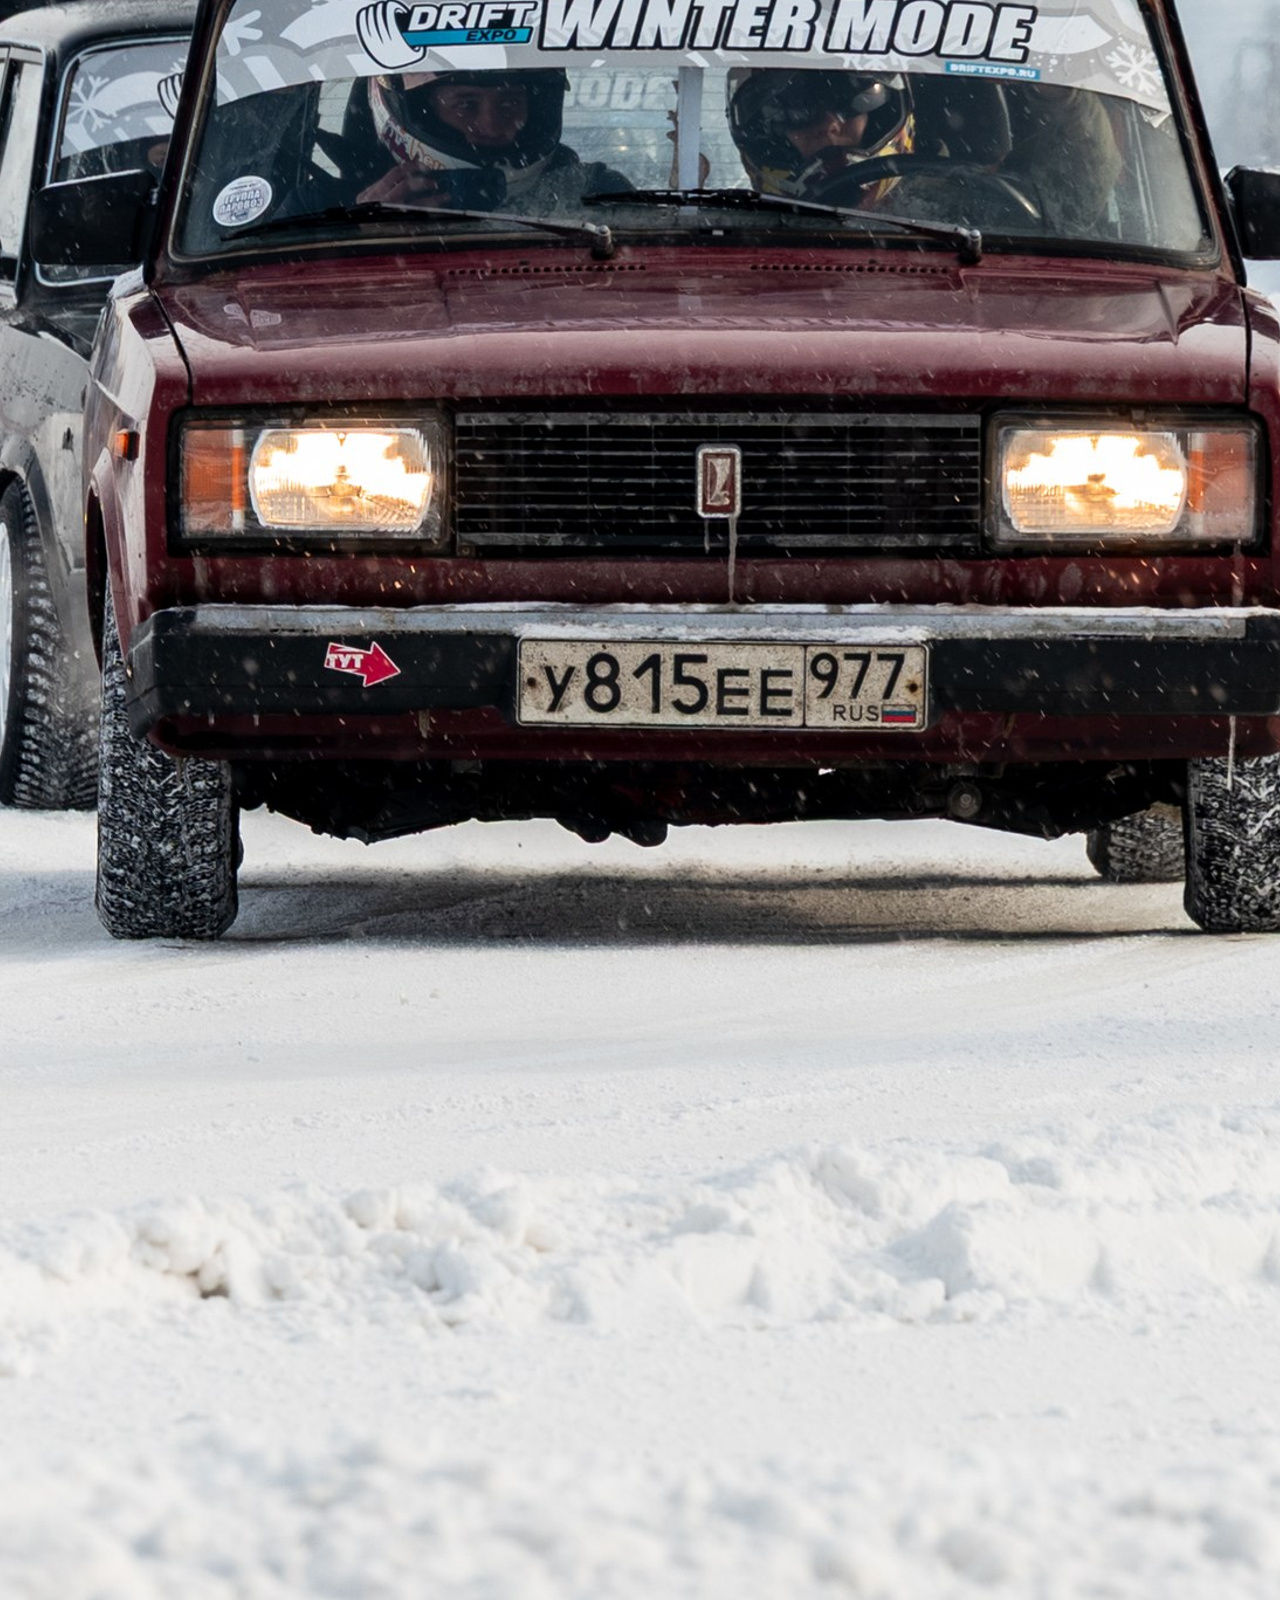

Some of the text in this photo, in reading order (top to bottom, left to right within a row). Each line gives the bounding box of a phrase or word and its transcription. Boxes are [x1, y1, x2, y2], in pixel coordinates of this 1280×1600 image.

[408, 2, 537, 31] DRIFT
[466, 29, 517, 42] EXPO
[949, 63, 1037, 78] DRIFTEXPO.RU
[327, 653, 364, 669] ТУТ
[810, 652, 906, 700] 977
[832, 704, 879, 722] RUS
